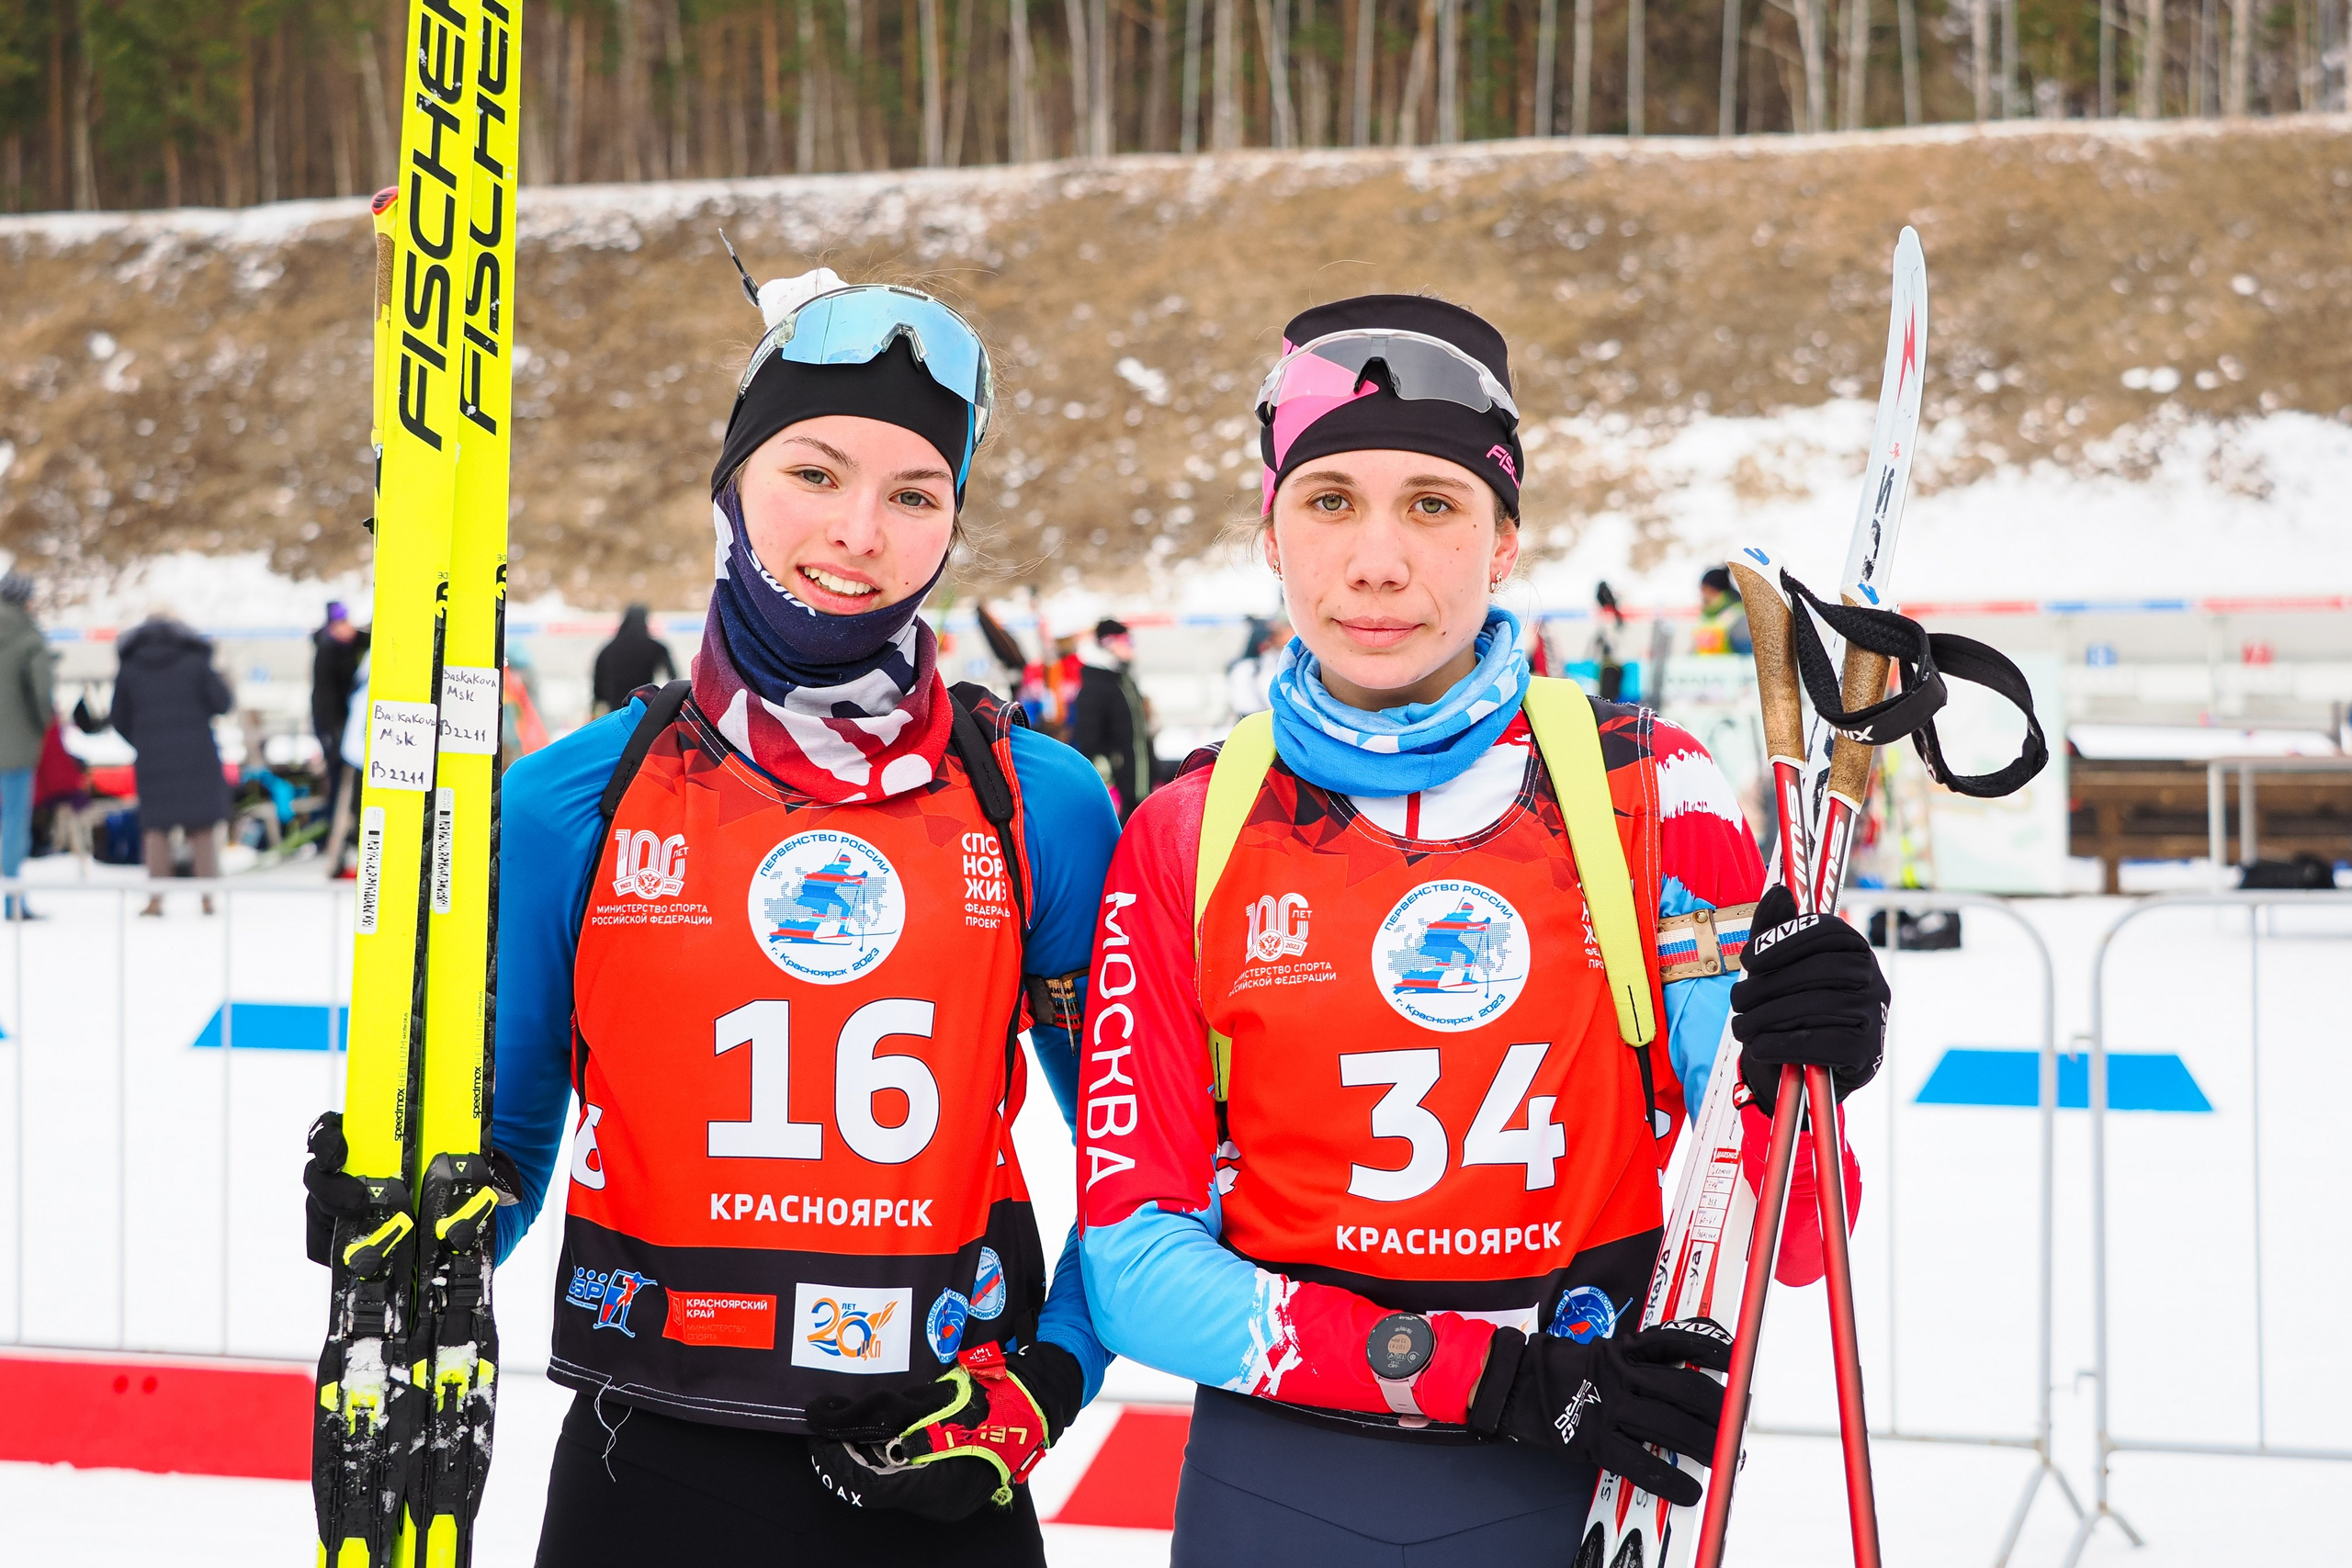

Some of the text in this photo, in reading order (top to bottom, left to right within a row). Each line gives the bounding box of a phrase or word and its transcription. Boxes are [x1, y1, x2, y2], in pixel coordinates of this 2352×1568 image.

[459, 0, 510, 436] FISCHE
[1486, 445, 1520, 490] FISC
[673, 846, 689, 859] ЛЕТ
[760, 833, 890, 877] ПЕРВЕНСТВО РОССИИ
[961, 832, 1001, 856] СПО
[963, 854, 1004, 878] НОР
[1819, 815, 1845, 914] SWI
[592, 913, 713, 926] РОССИЙСКОЙ ФЕДЕРАЦИИ
[596, 903, 708, 914] МИНИСТЕРСТВО СПОРТА
[1292, 909, 1312, 919] ЛЕТ
[1385, 884, 1514, 931] ПЕРВЕНСТВО РОССИИ
[1284, 942, 1300, 951] 2023
[780, 953, 848, 978] Красноярск
[852, 947, 880, 971] 2023
[1294, 962, 1332, 973] СПОРТА
[1274, 972, 1337, 986] ФЕДЕРАЦИИ
[1405, 1003, 1475, 1026] Красноярск
[1478, 993, 1507, 1018] 2023
[1084, 889, 1139, 1194] МОСКВА
[707, 997, 941, 1165] 16
[1339, 1043, 1566, 1202] 34
[709, 1192, 933, 1227] КРАСНОЯРСК
[1335, 1220, 1563, 1256] КРАСНОЯРСК
[685, 1298, 768, 1311] КРАСНОЯРСКИЙ
[685, 1308, 715, 1318] КРАЙ
[842, 1303, 856, 1311] ЛЕТ
[686, 1324, 746, 1333] МИНИСТЕРСТВО
[687, 1333, 718, 1341] СПОРТА
